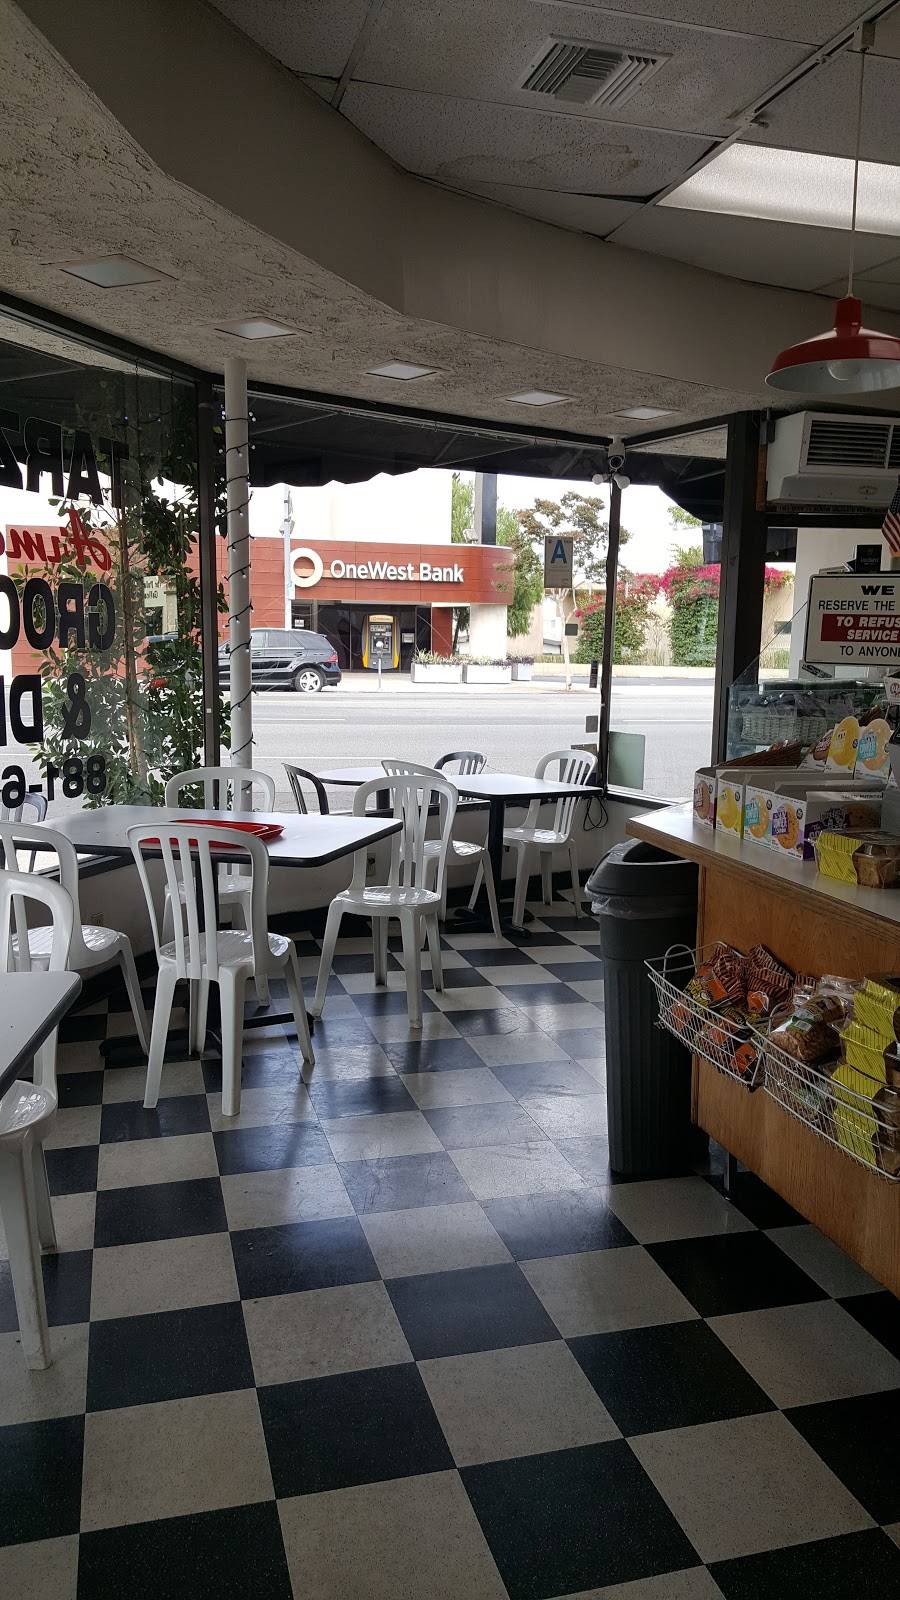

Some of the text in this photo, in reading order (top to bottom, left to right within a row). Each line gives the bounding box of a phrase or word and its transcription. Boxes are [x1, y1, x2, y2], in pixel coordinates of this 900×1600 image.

[550, 539, 567, 564] A
[330, 559, 464, 582] OneWest Bank
[861, 585, 895, 595] WE
[818, 600, 895, 611] RESERVE THE
[837, 616, 854, 627] TO
[847, 629, 900, 641] SERVICE
[840, 645, 900, 657] TO ANYON
